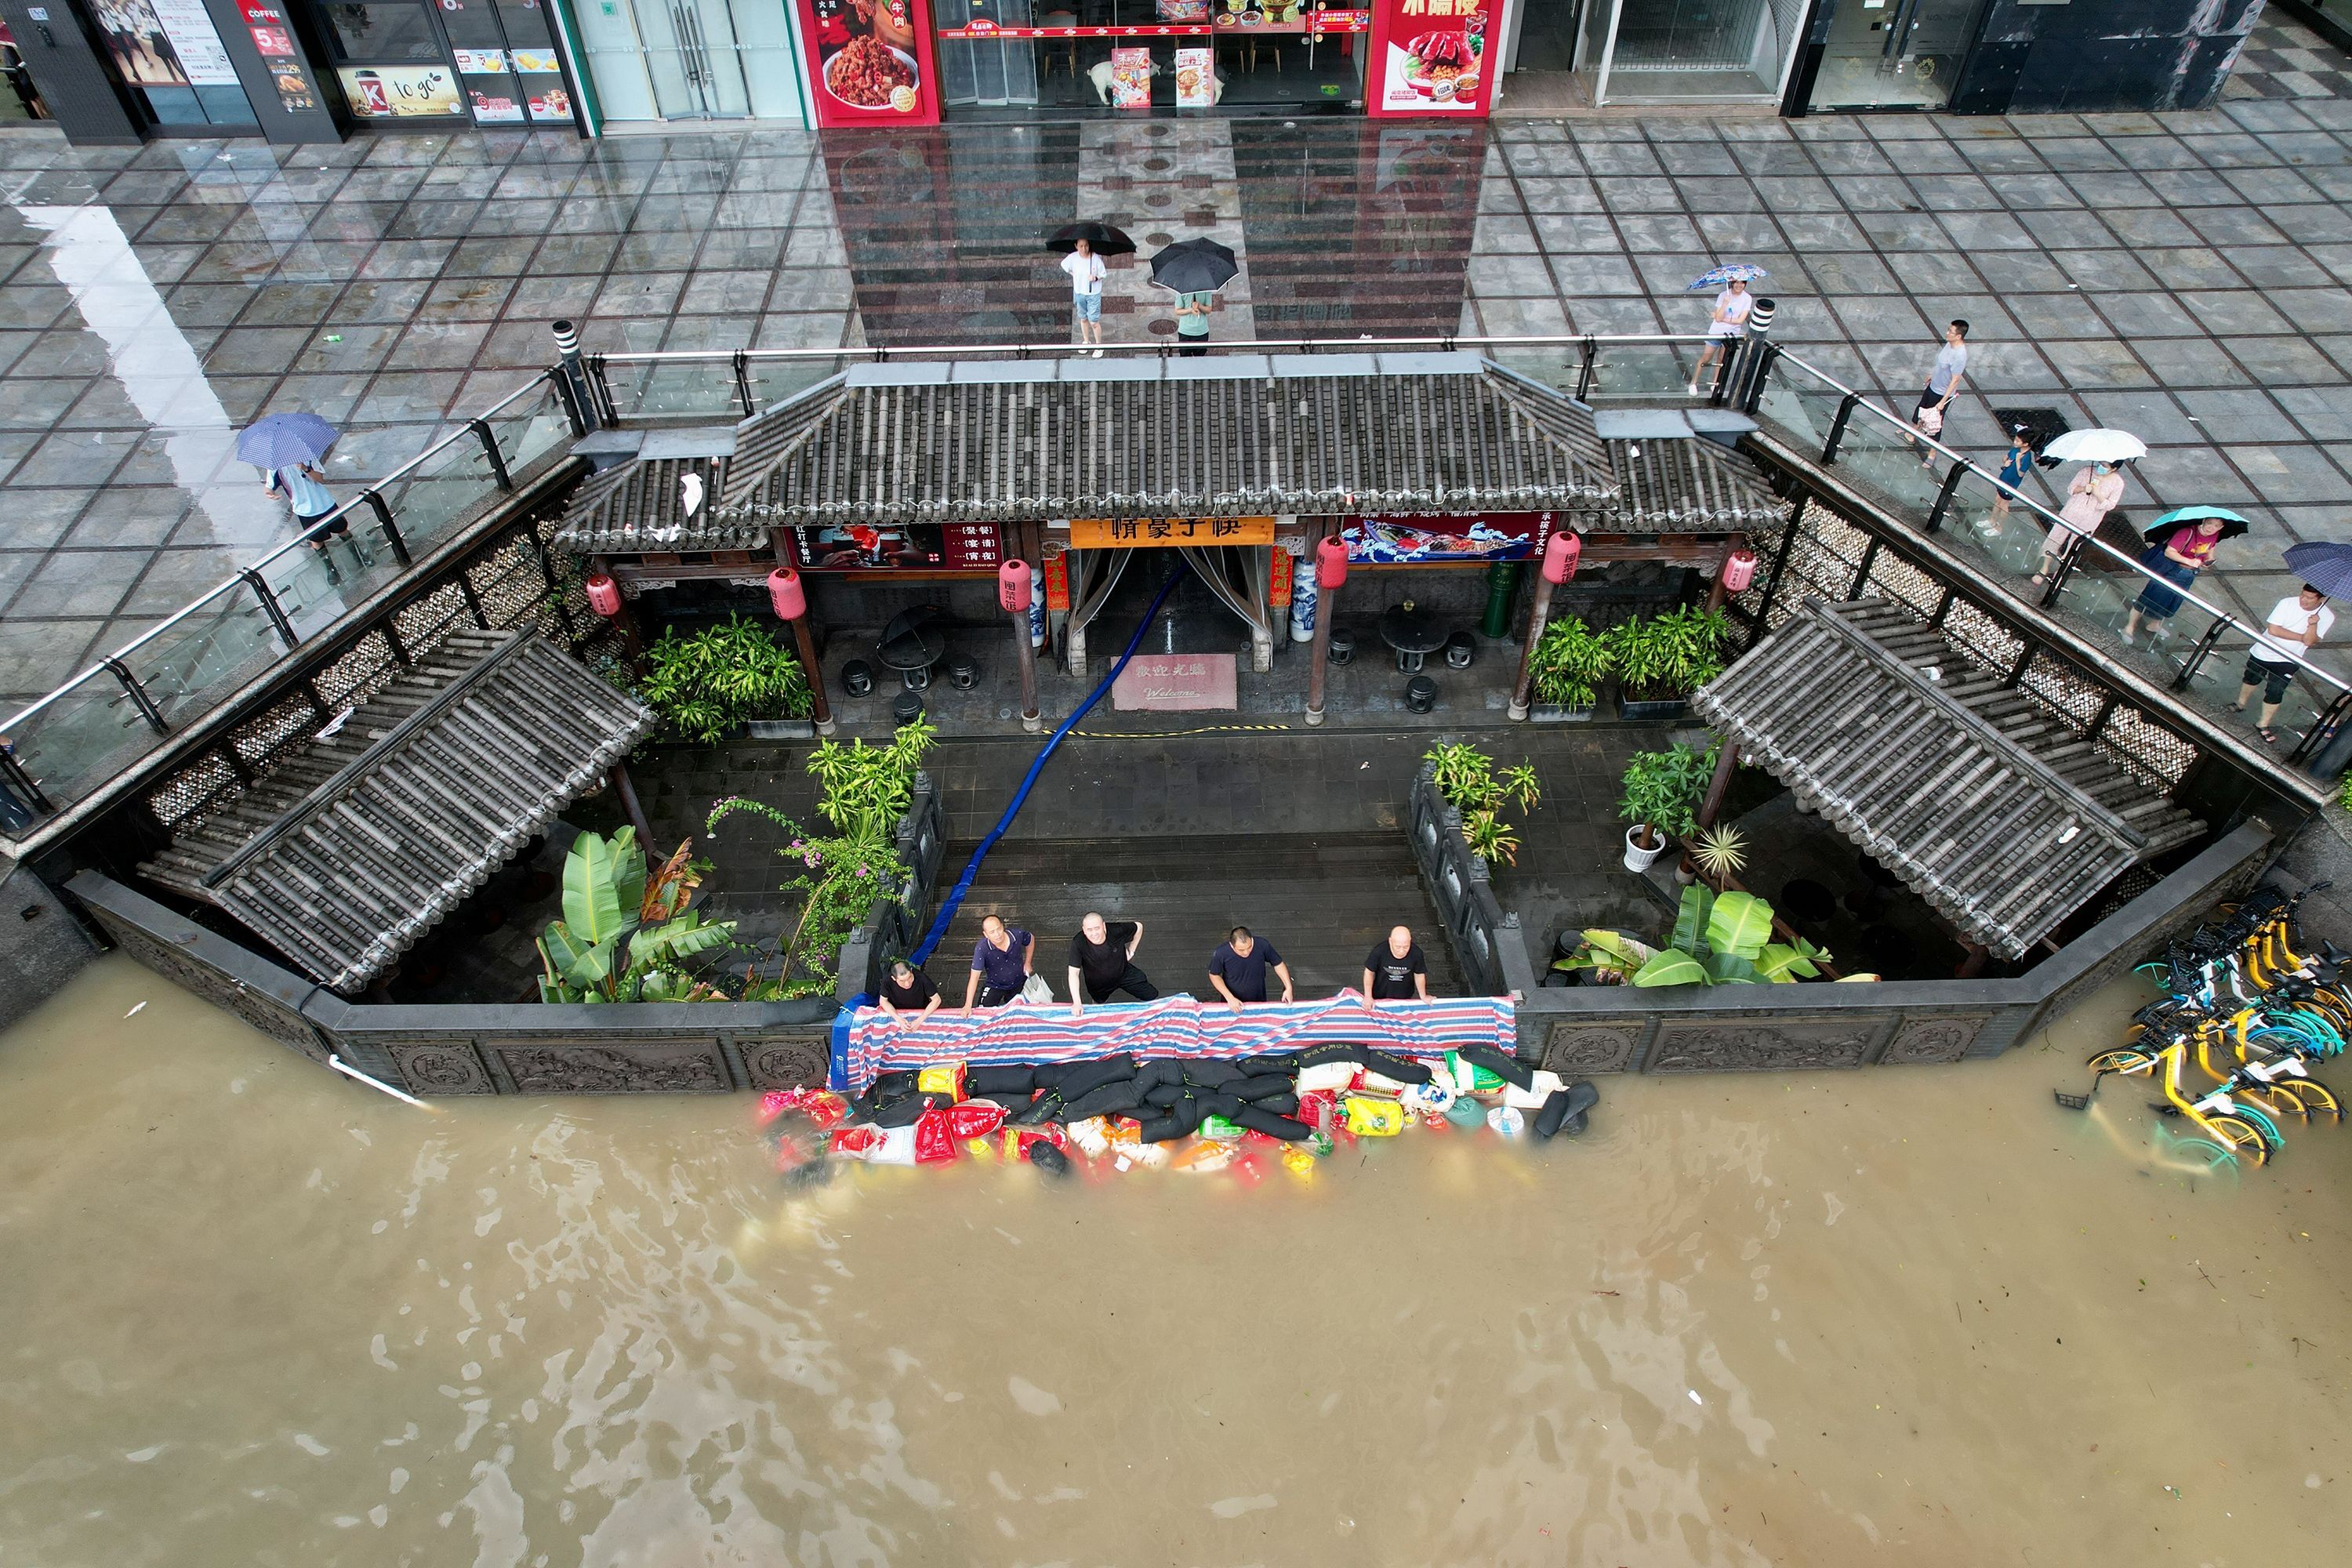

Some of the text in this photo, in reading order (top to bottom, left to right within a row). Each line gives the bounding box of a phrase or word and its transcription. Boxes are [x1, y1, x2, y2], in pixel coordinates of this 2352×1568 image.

[891, 2, 905, 27] 牛肉
[255, 29, 272, 47] 5
[361, 85, 386, 106] K
[418, 78, 435, 100] go
[1004, 579, 1017, 610] 闽菜馆
[1144, 687, 1200, 700] Welcome
